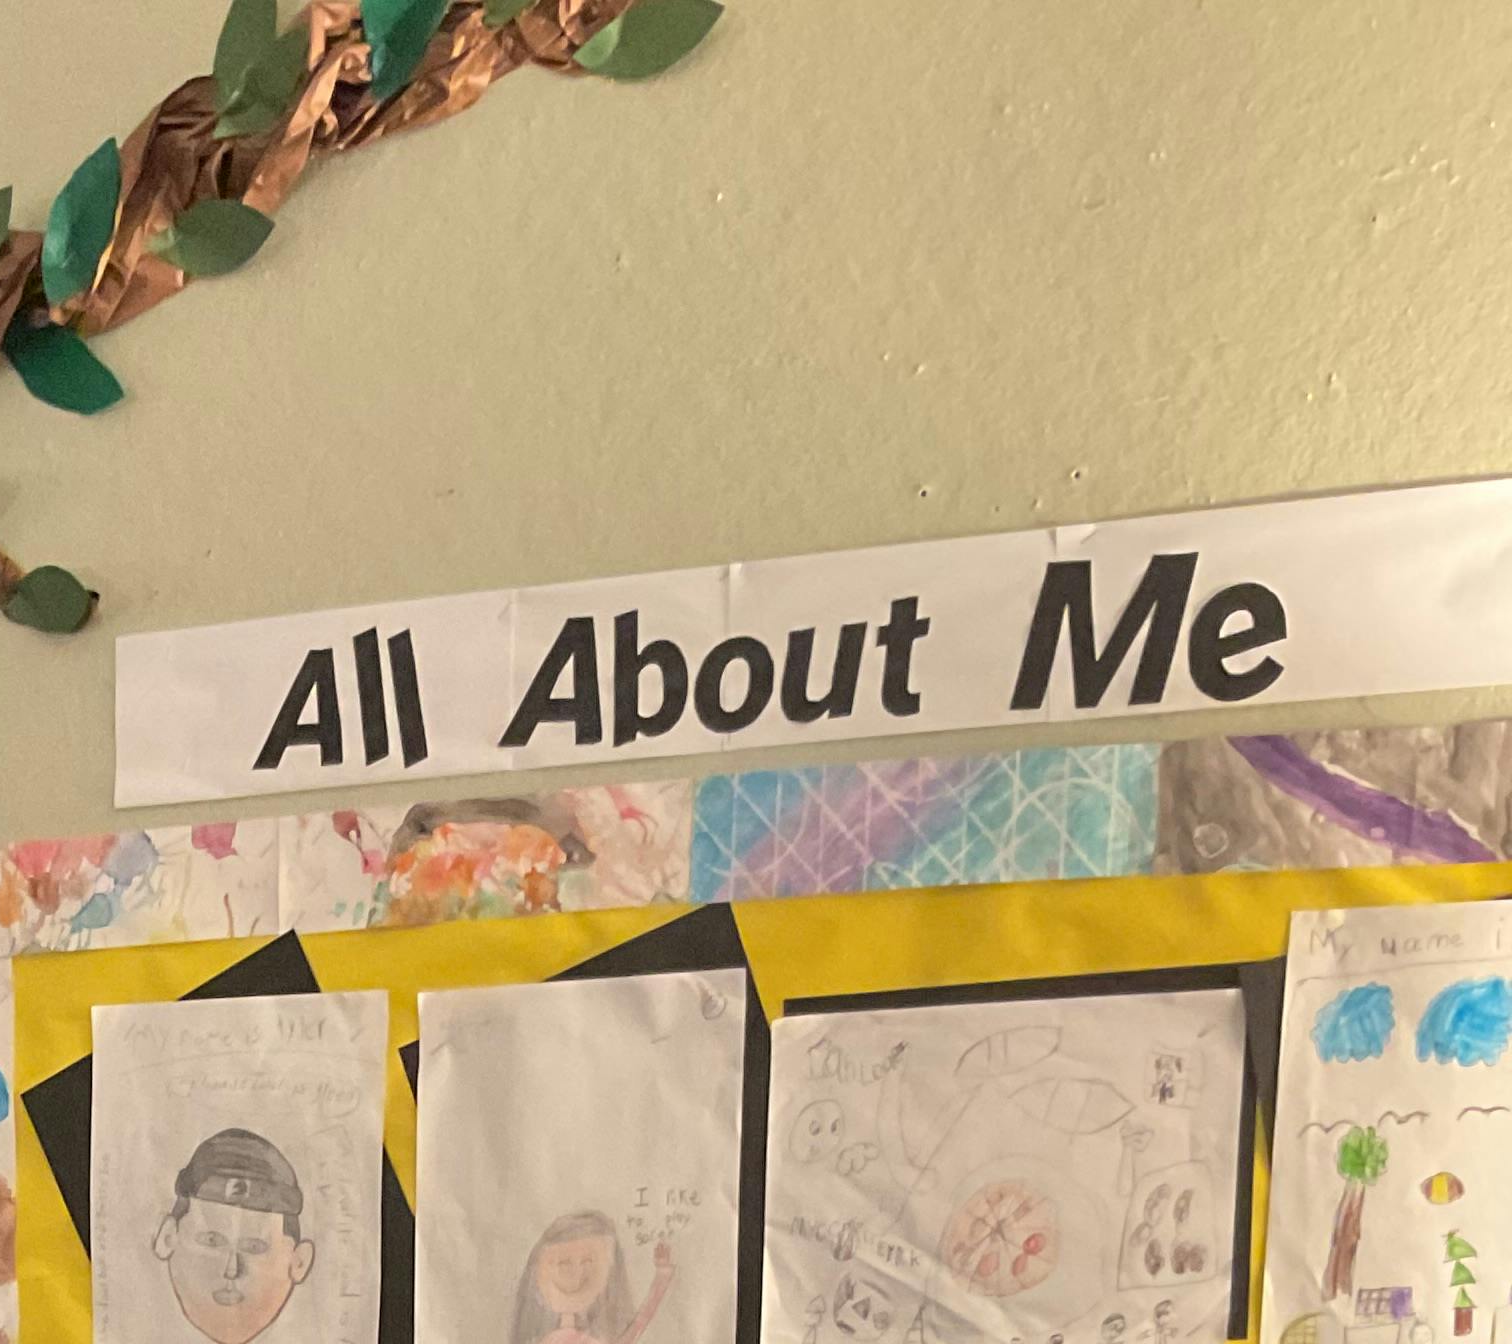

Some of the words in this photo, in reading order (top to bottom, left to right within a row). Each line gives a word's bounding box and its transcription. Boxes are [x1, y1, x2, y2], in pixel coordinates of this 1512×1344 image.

[252, 625, 428, 770] All
[498, 595, 930, 749] About
[1010, 551, 1290, 711] Me
[634, 1186, 649, 1208] I
